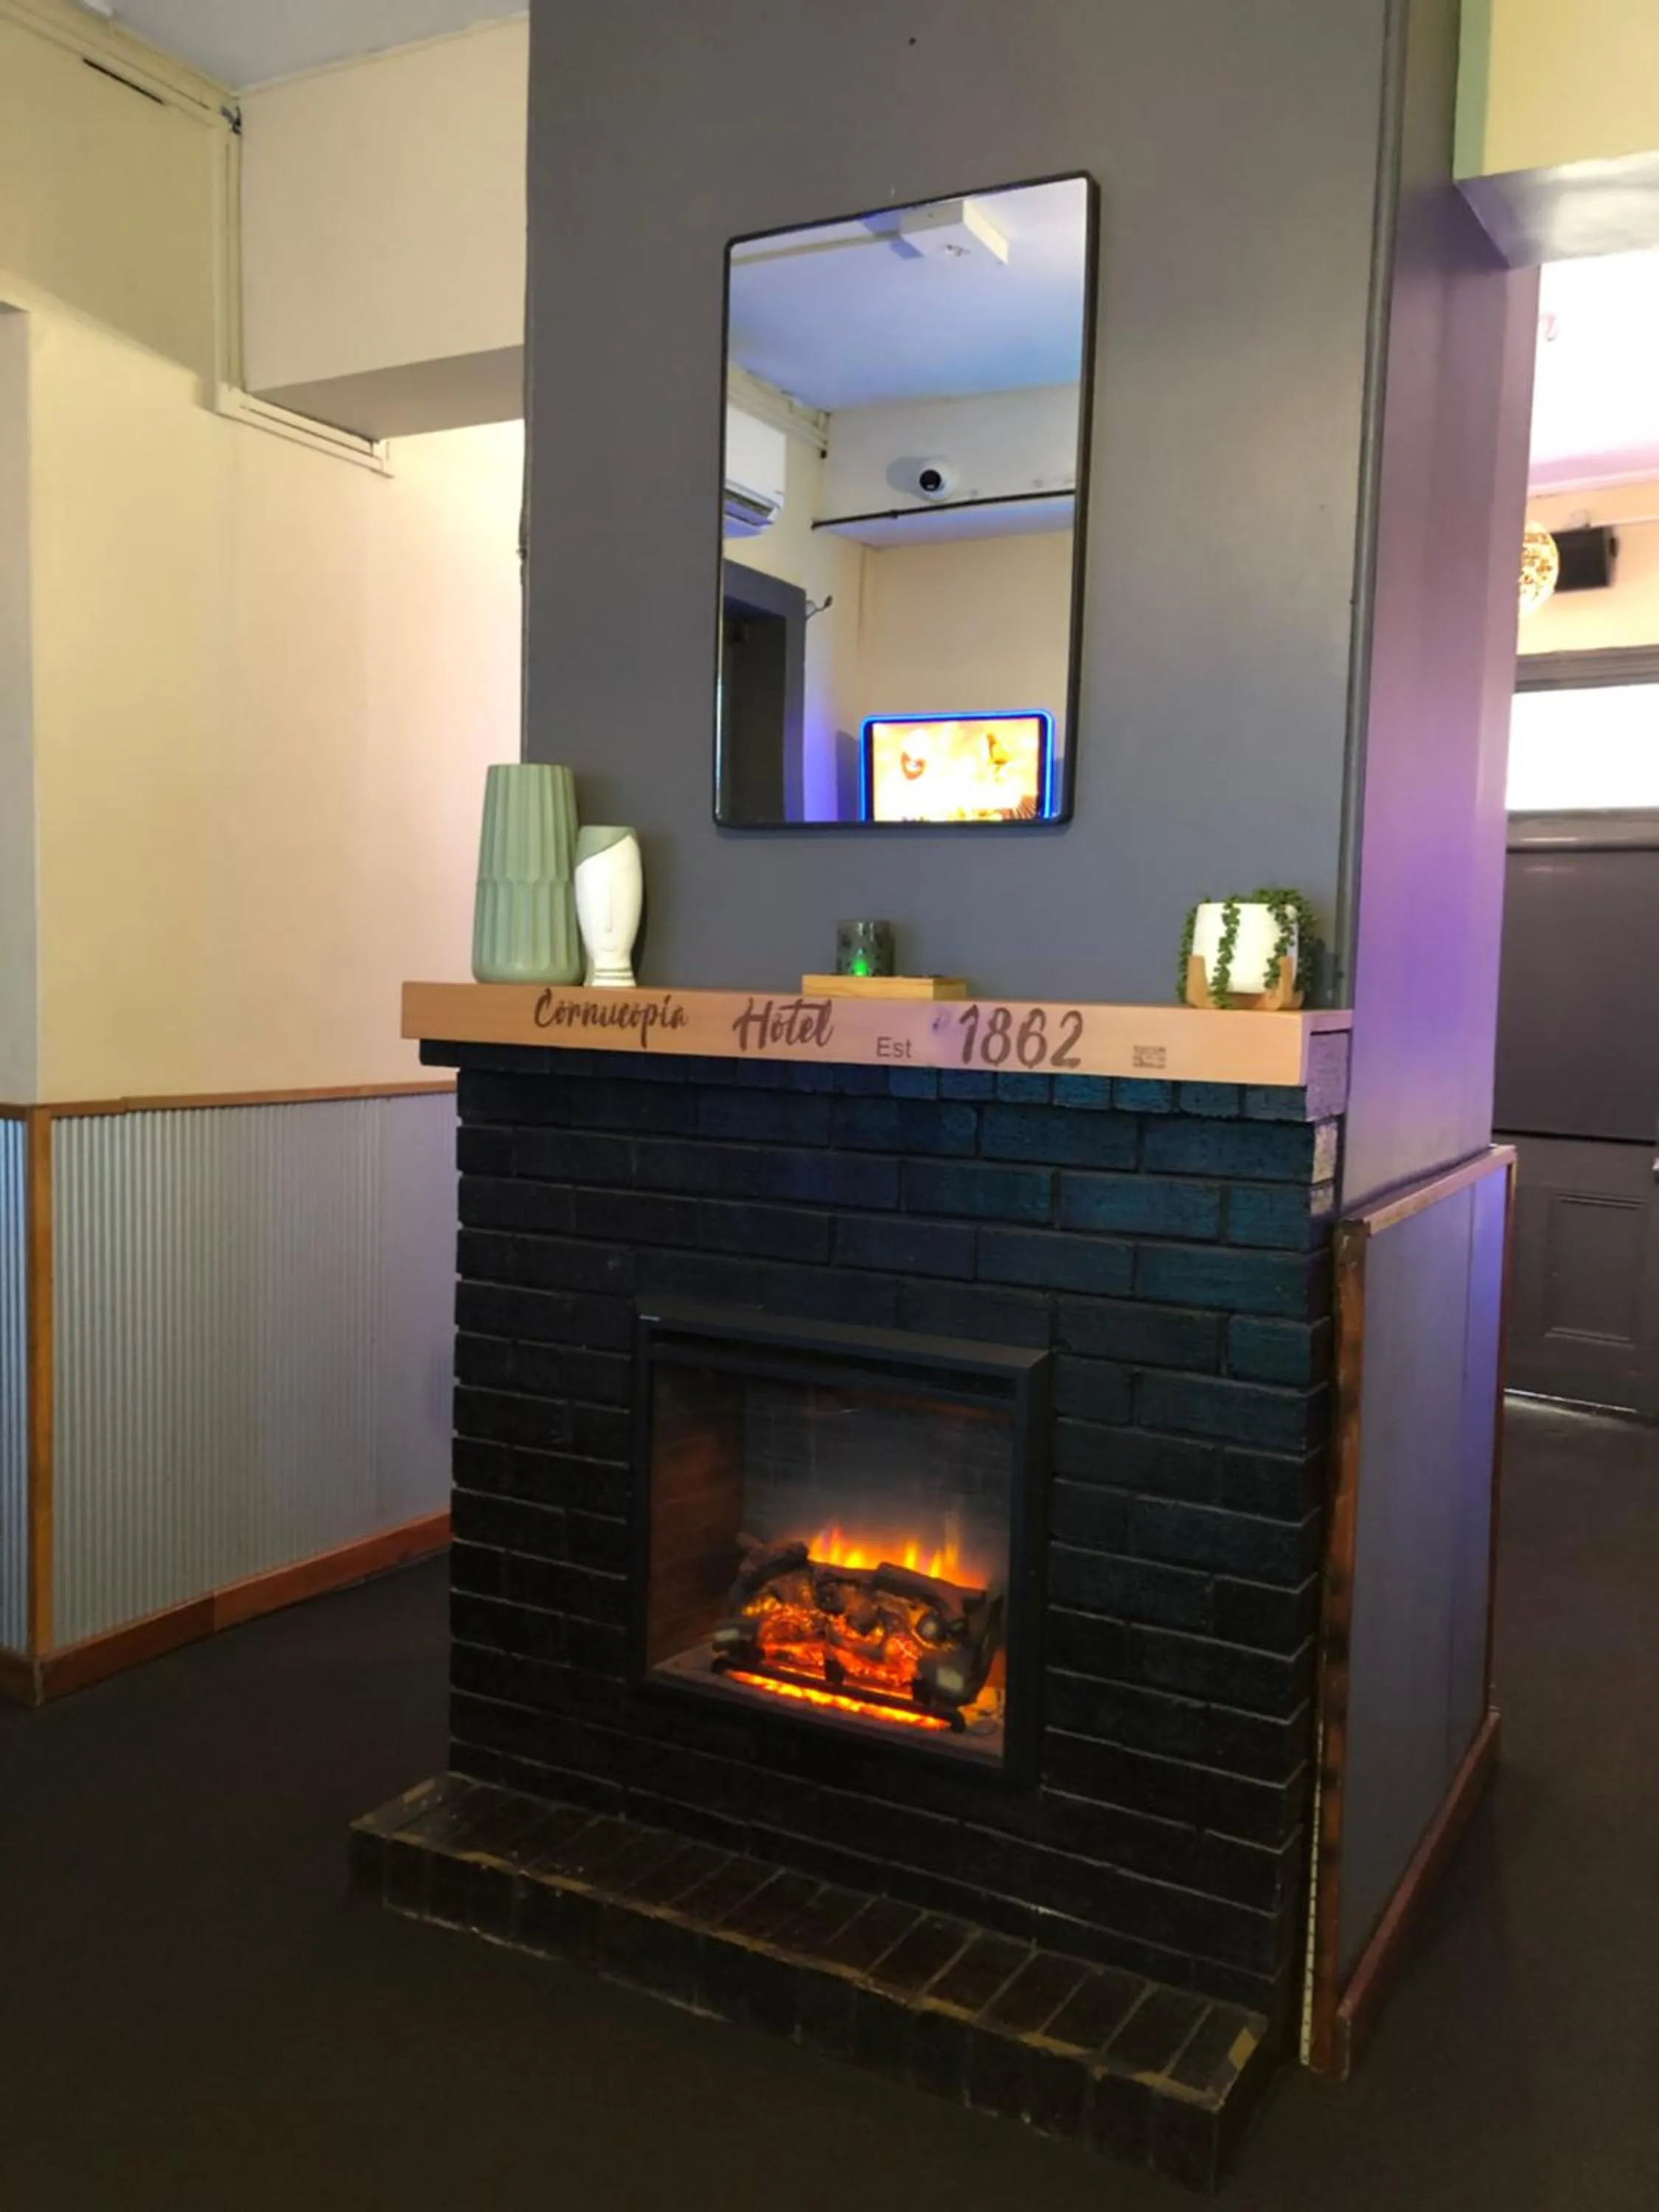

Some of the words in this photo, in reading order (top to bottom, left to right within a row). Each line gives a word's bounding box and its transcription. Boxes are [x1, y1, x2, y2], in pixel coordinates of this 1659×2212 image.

[534, 987, 689, 1048] Cornucopia
[732, 997, 835, 1051] Hotel
[876, 1036, 911, 1059] Est
[959, 1004, 1084, 1069] 1862
